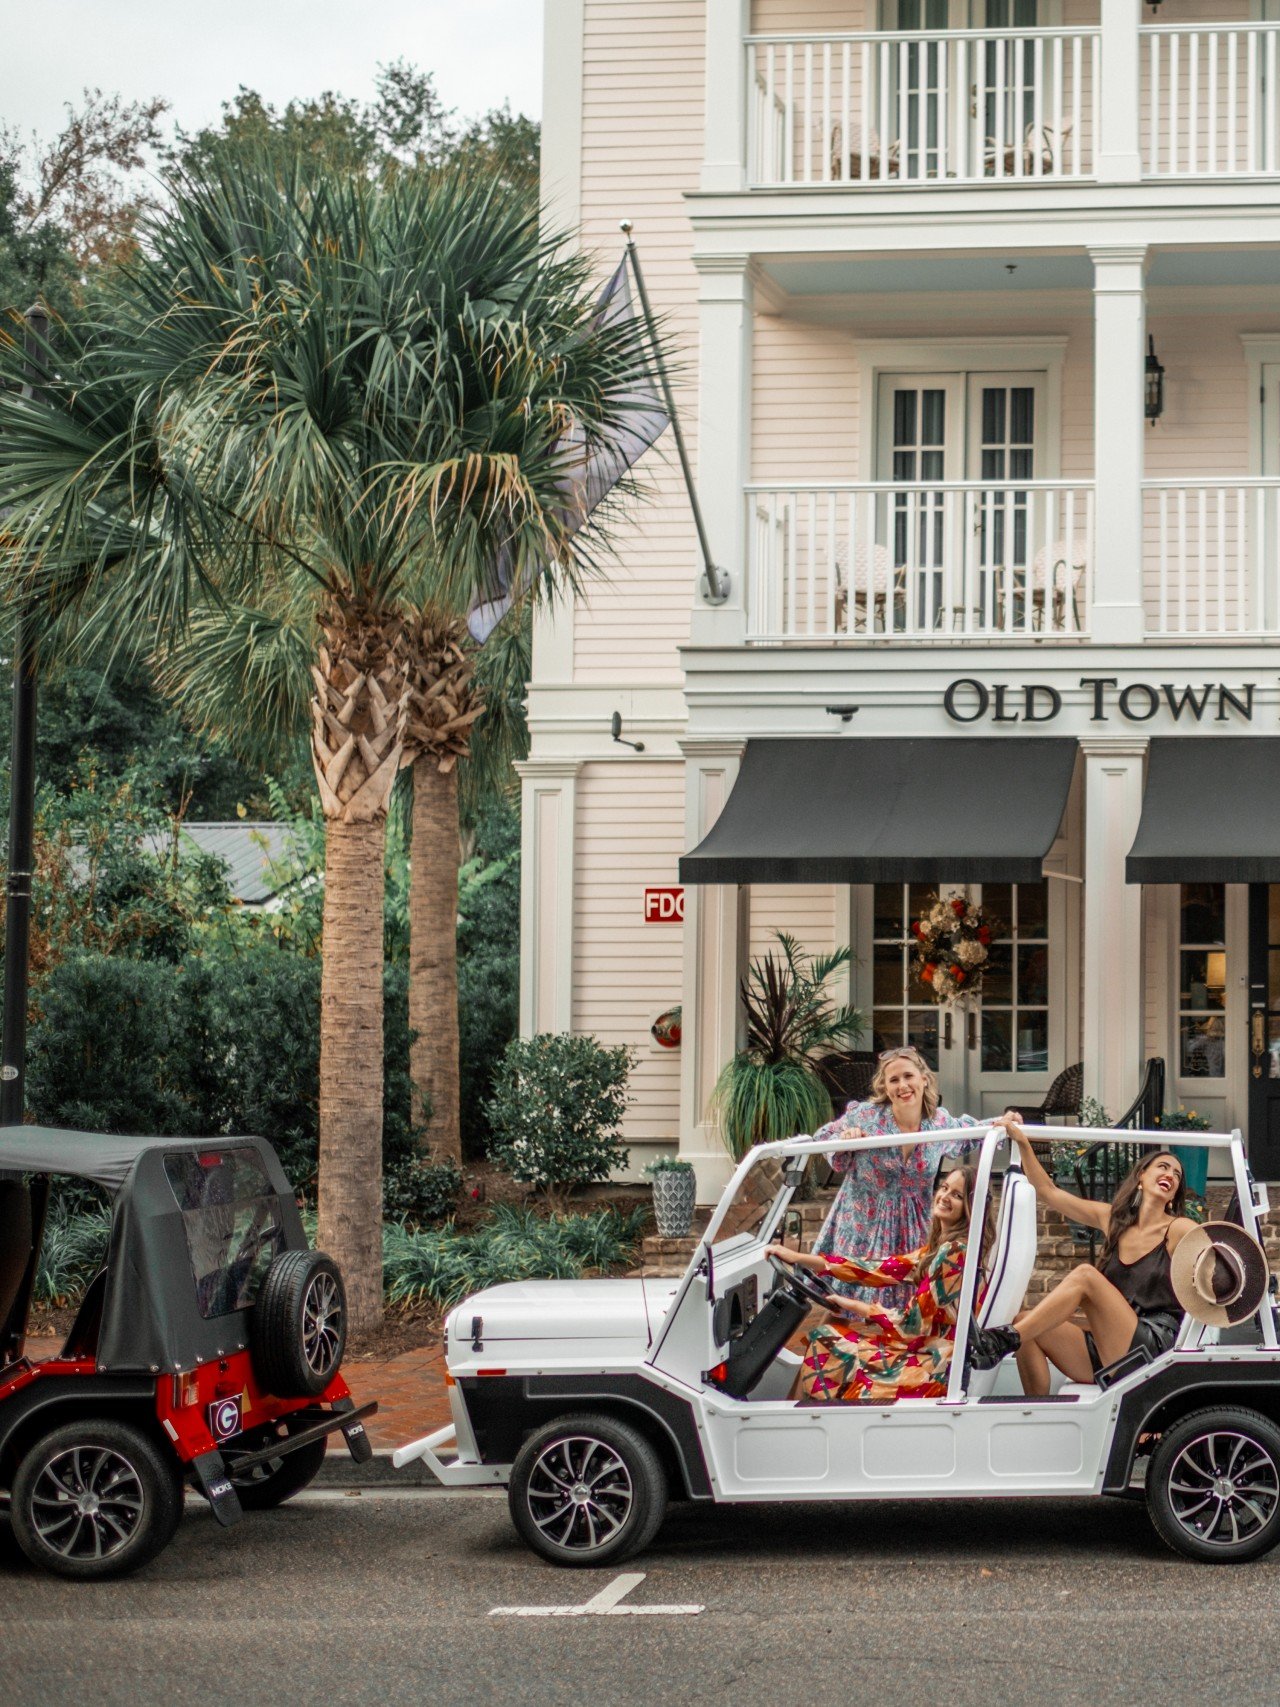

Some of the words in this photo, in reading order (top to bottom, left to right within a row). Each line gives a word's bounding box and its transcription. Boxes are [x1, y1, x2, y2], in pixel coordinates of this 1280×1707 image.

[943, 678, 1062, 723] OLD
[1079, 677, 1255, 722] TOWN
[211, 1482, 233, 1497] MOKE
